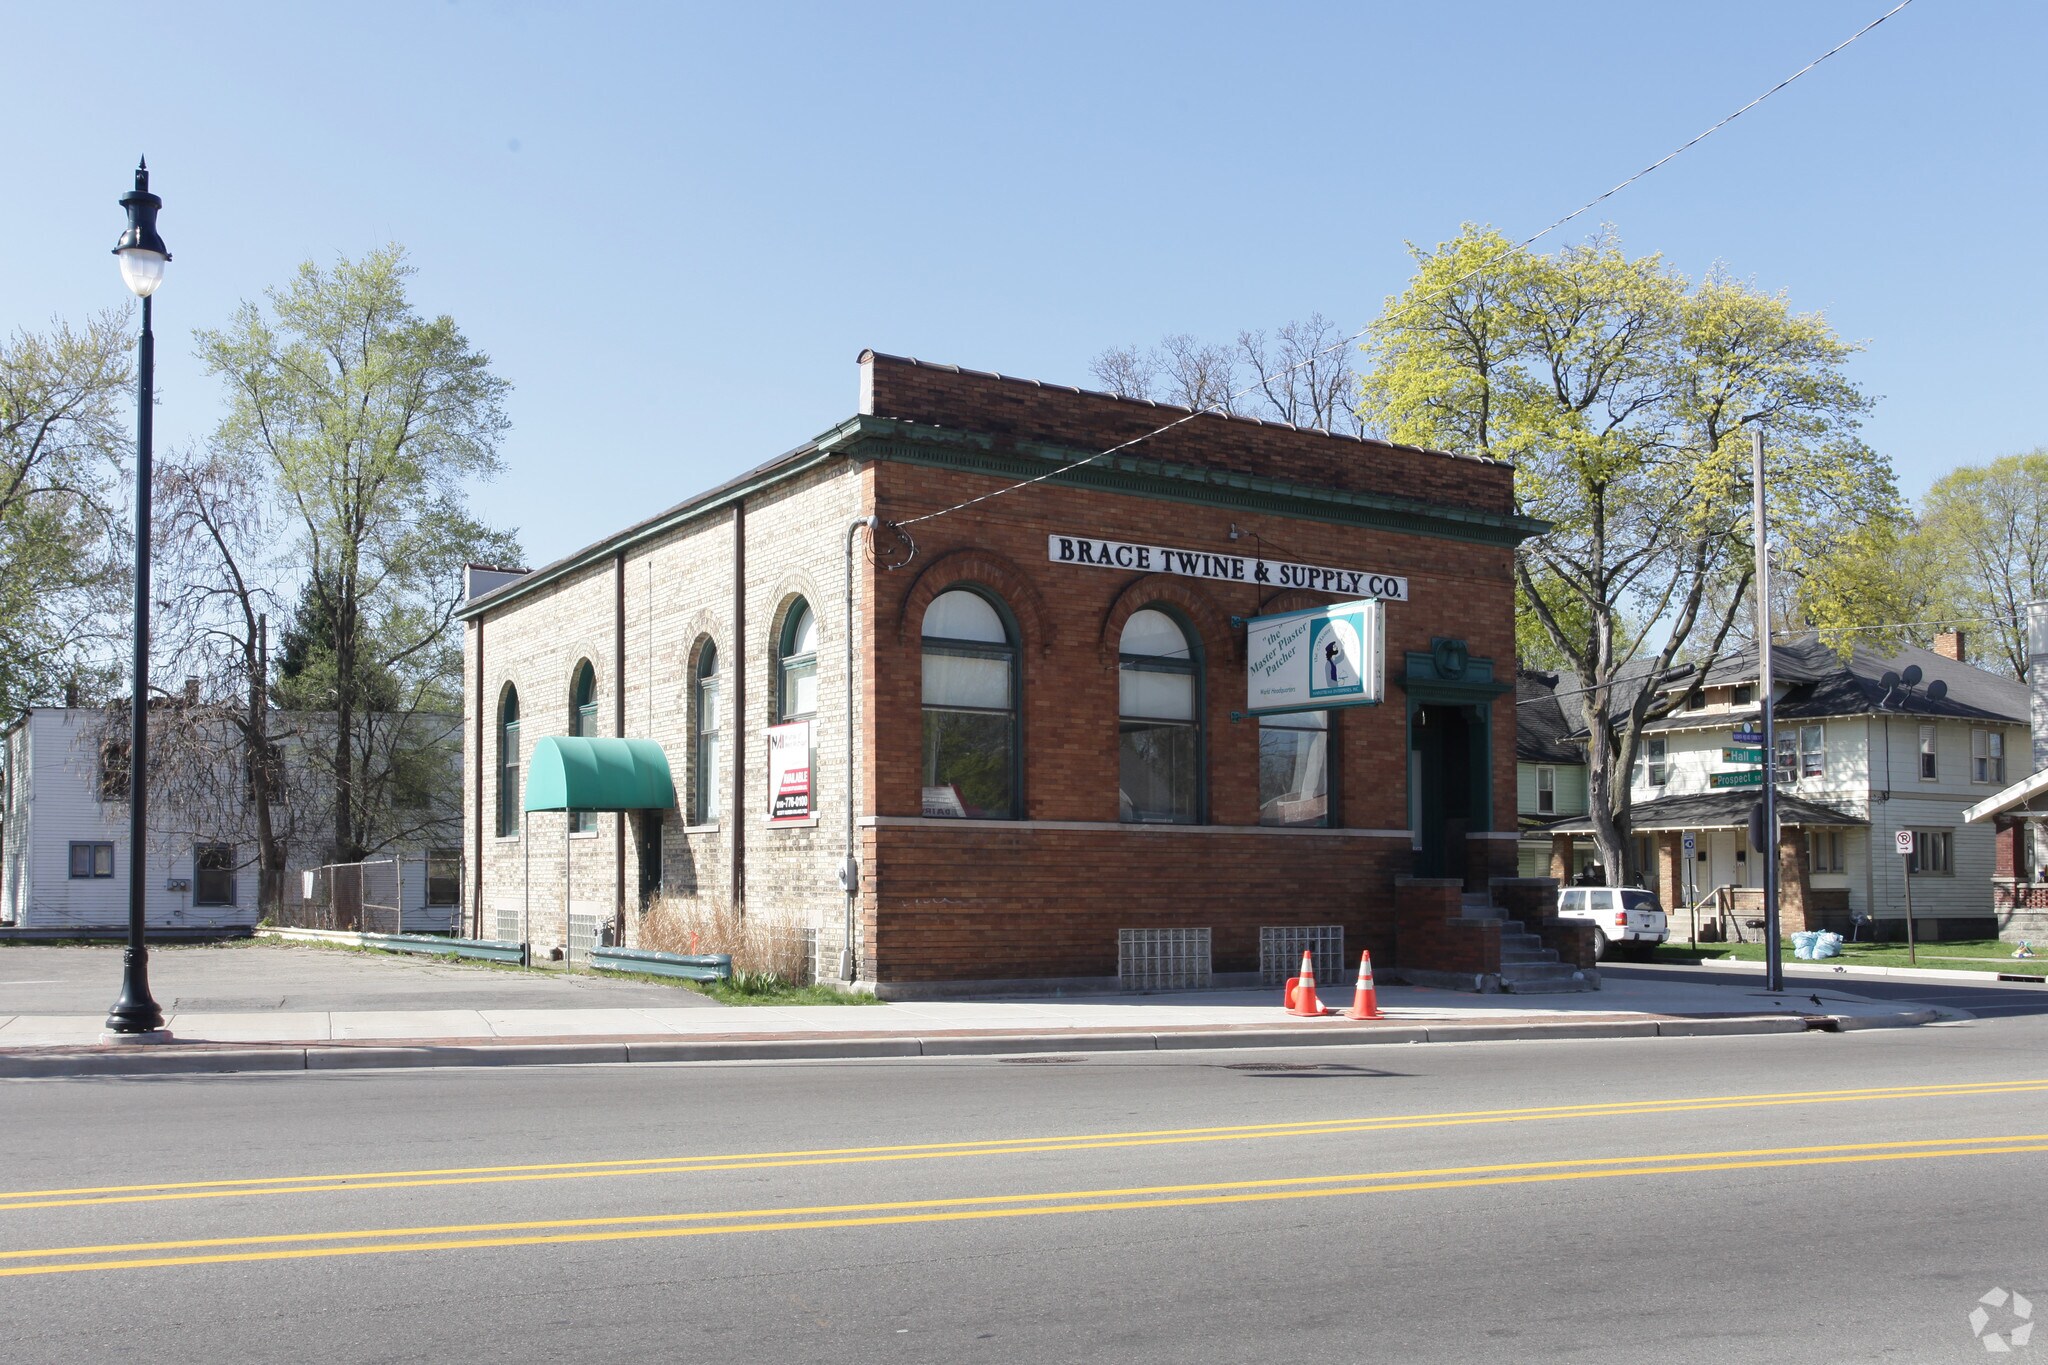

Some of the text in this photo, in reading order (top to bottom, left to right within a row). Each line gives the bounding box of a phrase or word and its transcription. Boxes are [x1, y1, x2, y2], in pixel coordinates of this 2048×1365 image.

[1058, 538, 1402, 598] BRACE TWINE & SUPPLY CO.
[1262, 624, 1283, 646] "the"
[1249, 648, 1277, 677] Master
[1279, 622, 1307, 651] Plaster
[1265, 646, 1297, 677] Patcher
[1270, 686, 1296, 695] Headquarters
[1731, 750, 1749, 761] Hall
[1717, 773, 1751, 786] Prospect
